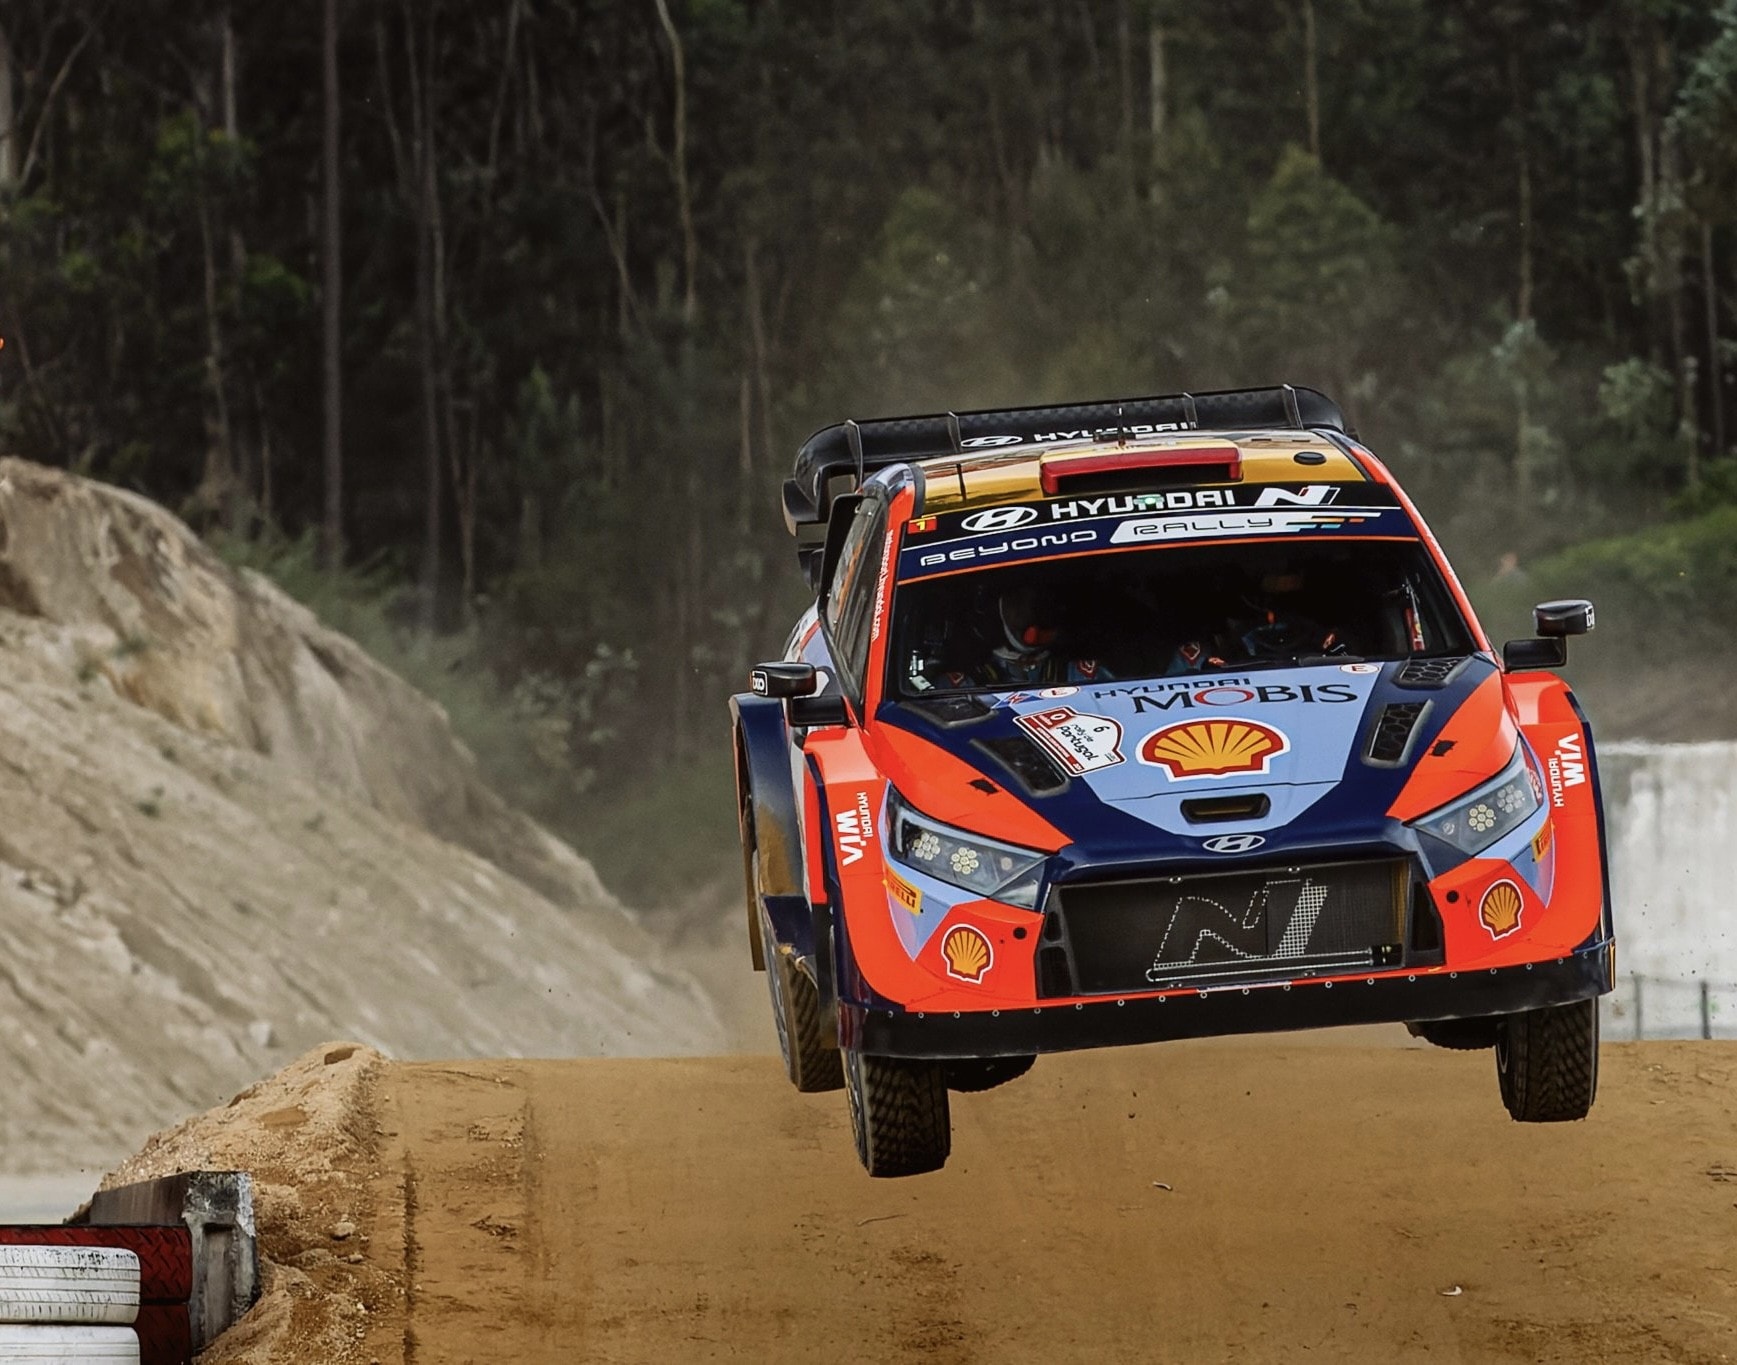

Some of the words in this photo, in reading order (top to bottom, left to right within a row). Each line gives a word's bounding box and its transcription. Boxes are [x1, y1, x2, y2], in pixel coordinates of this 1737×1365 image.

[1051, 489, 1236, 520] HYUNDAI
[919, 529, 1098, 567] BEYOND
[1133, 518, 1274, 535] RALLY
[1094, 677, 1251, 699] HYUNDAI
[1133, 683, 1358, 714] MOBIS
[1548, 757, 1565, 808] HYUNDAI
[856, 791, 874, 838] HYUNDAI
